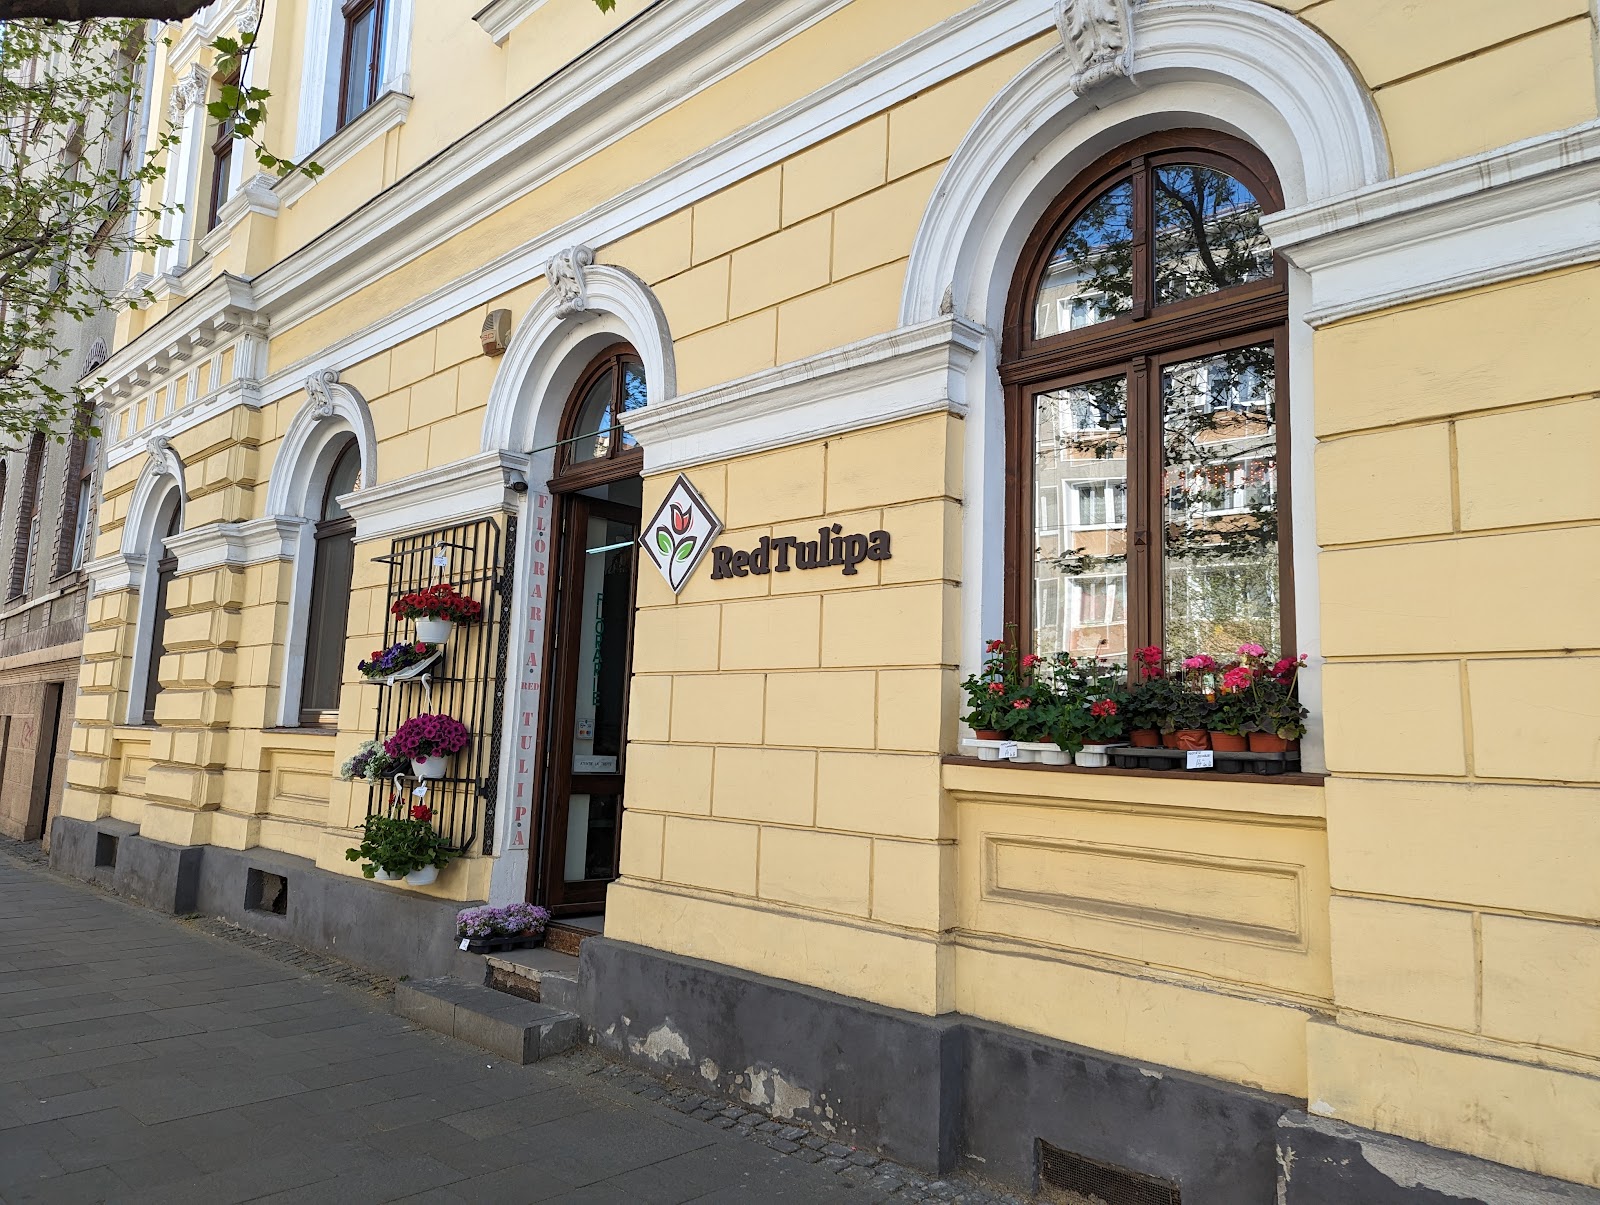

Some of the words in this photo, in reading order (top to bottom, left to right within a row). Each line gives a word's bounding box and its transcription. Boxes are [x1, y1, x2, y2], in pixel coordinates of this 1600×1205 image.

[526, 494, 549, 667] FLORARIA
[520, 681, 540, 691] RED
[511, 711, 534, 847] TULIPA
